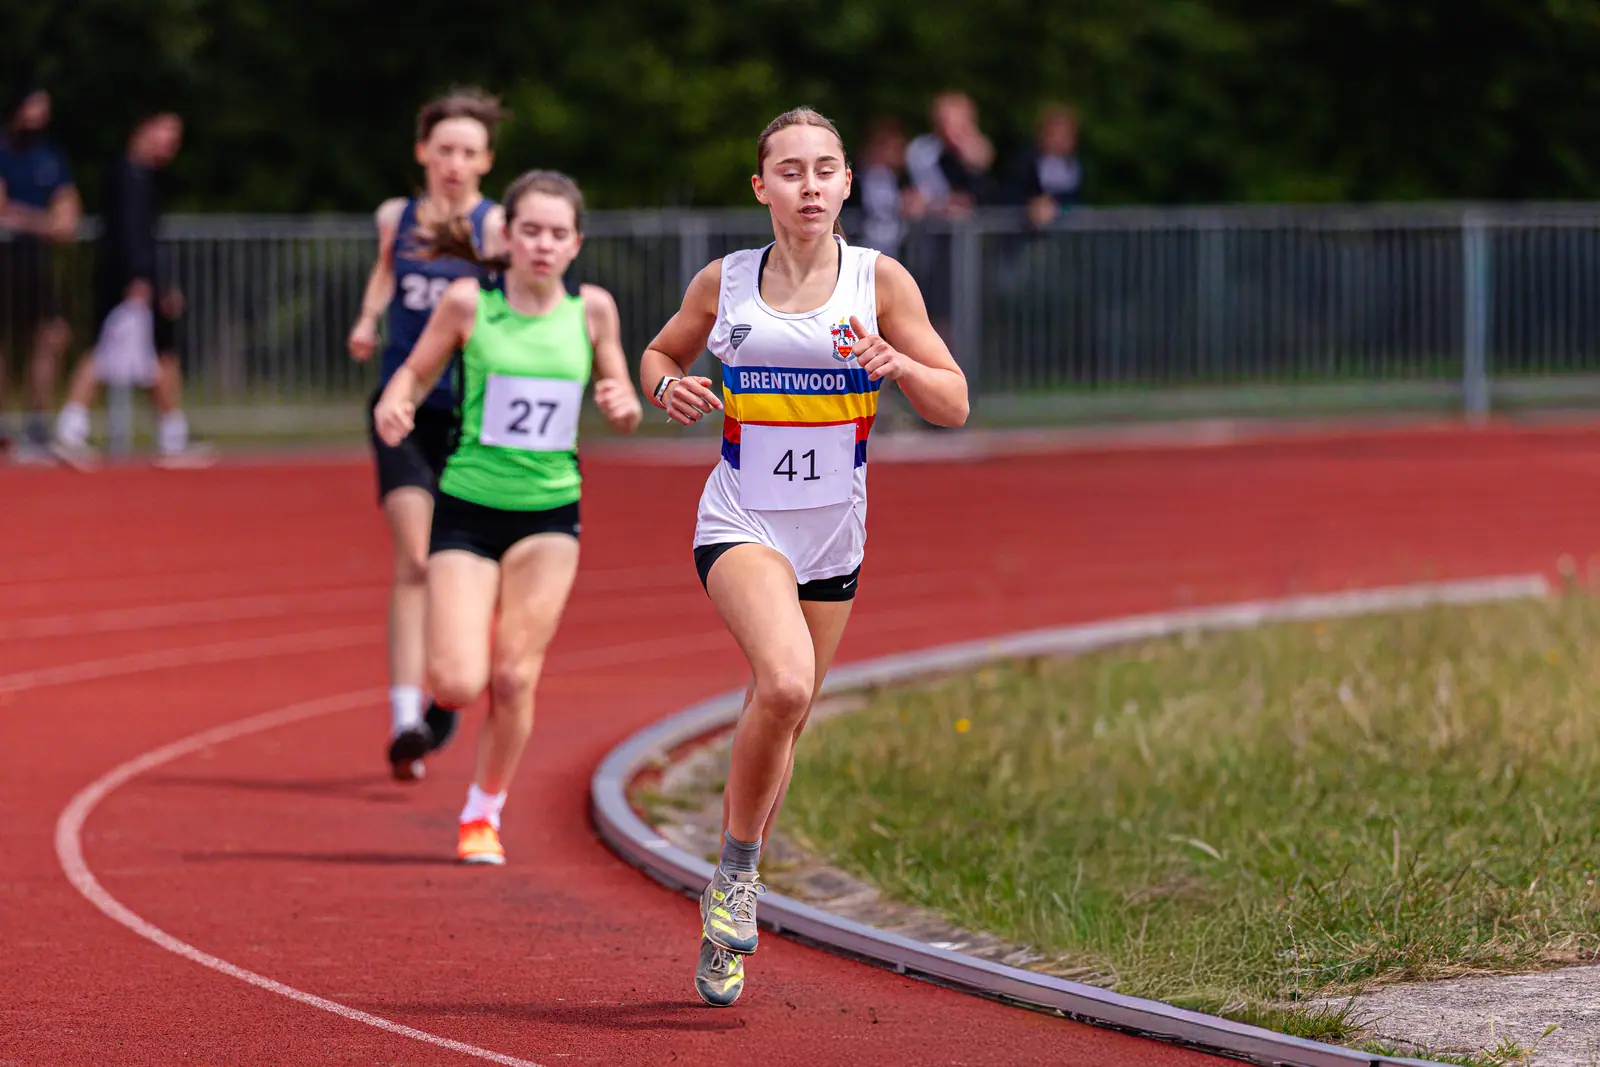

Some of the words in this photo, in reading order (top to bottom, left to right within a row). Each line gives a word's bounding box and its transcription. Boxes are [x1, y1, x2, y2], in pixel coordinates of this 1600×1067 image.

[739, 371, 846, 391] BRENTWOOD
[507, 397, 560, 437] 27
[773, 449, 821, 482] 41
